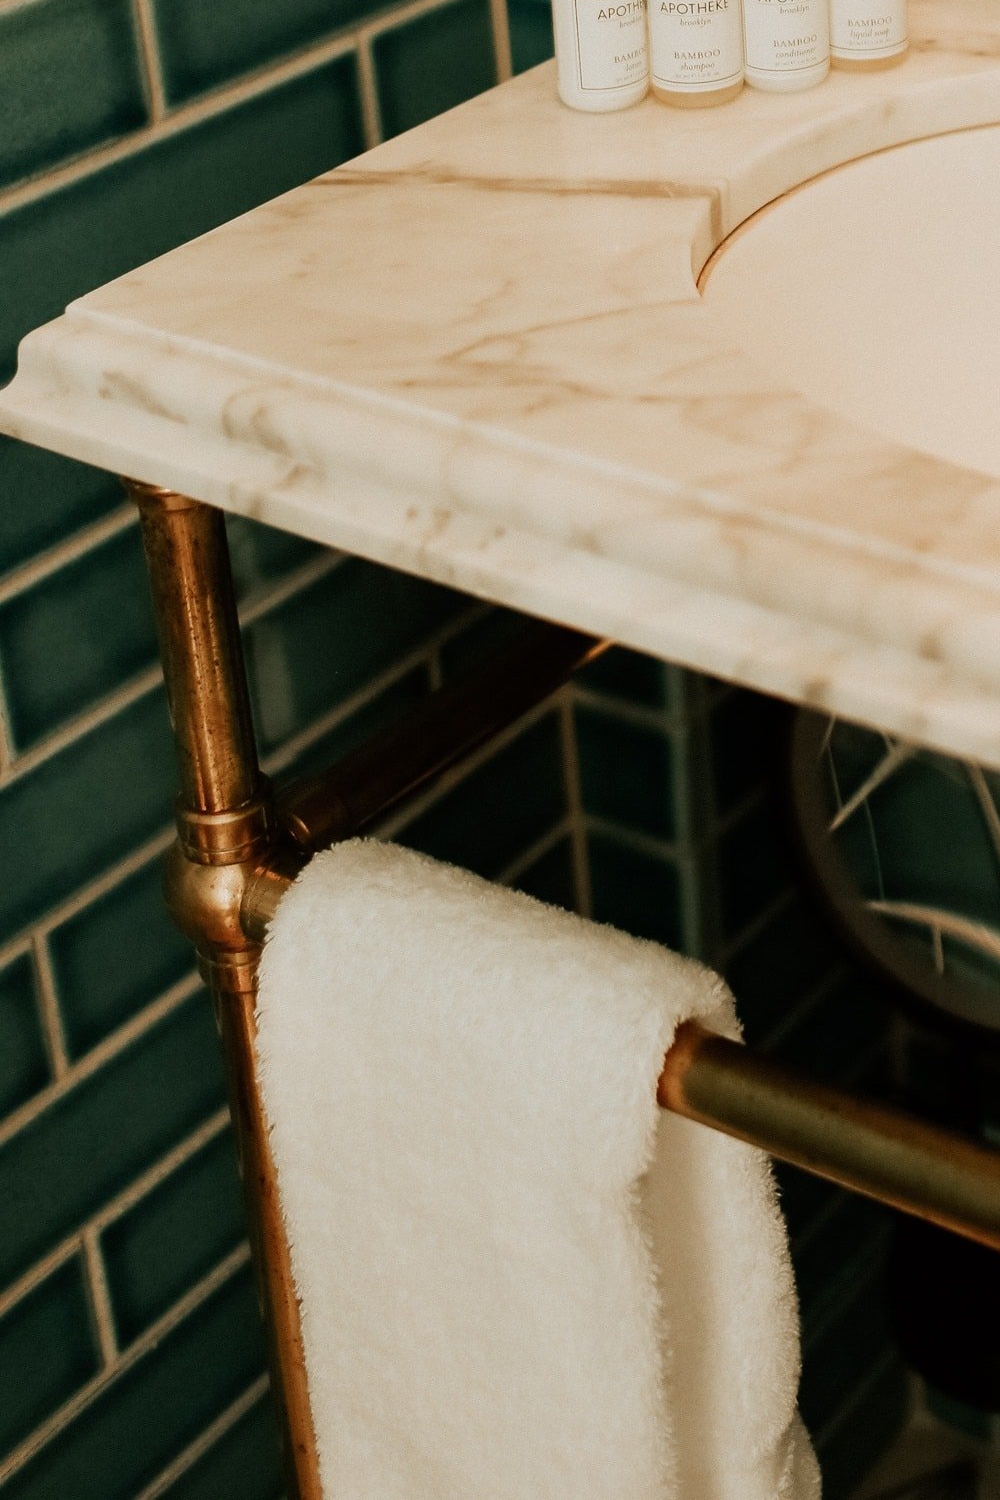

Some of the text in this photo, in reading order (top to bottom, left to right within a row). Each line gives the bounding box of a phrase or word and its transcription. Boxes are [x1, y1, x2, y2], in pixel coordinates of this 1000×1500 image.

[779, 5, 810, 15] brooklyn
[679, 17, 712, 28] brooklyn
[847, 16, 893, 28] BAMBOO
[773, 34, 818, 48] BAMBOO
[614, 47, 645, 64] BAMBO
[674, 49, 721, 60] BAMBOO
[680, 61, 716, 73] shampoo
